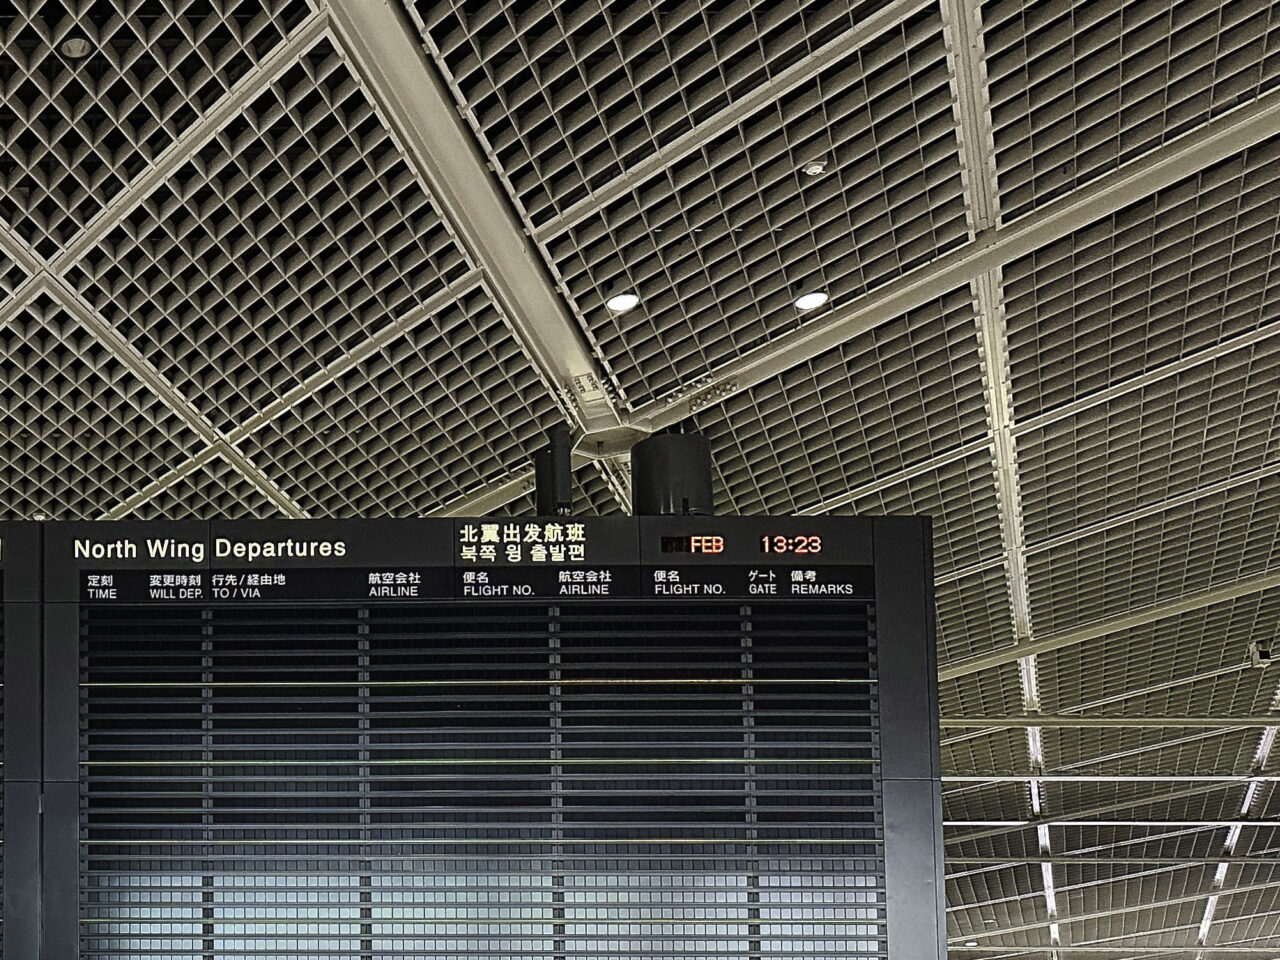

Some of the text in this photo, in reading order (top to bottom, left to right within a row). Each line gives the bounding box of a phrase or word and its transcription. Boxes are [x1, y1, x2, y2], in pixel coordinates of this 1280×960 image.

[460, 524, 585, 543] 北翼出发航班
[74, 539, 346, 562] North Wing Departures
[691, 537, 723, 552] FEB
[762, 537, 821, 553] 13:23
[460, 544, 585, 561] 북쪽 윙 출발편
[89, 589, 116, 598] TIME
[369, 586, 418, 597] AIRLINE
[750, 584, 776, 594] GATE
[792, 584, 853, 594] REMARKS
